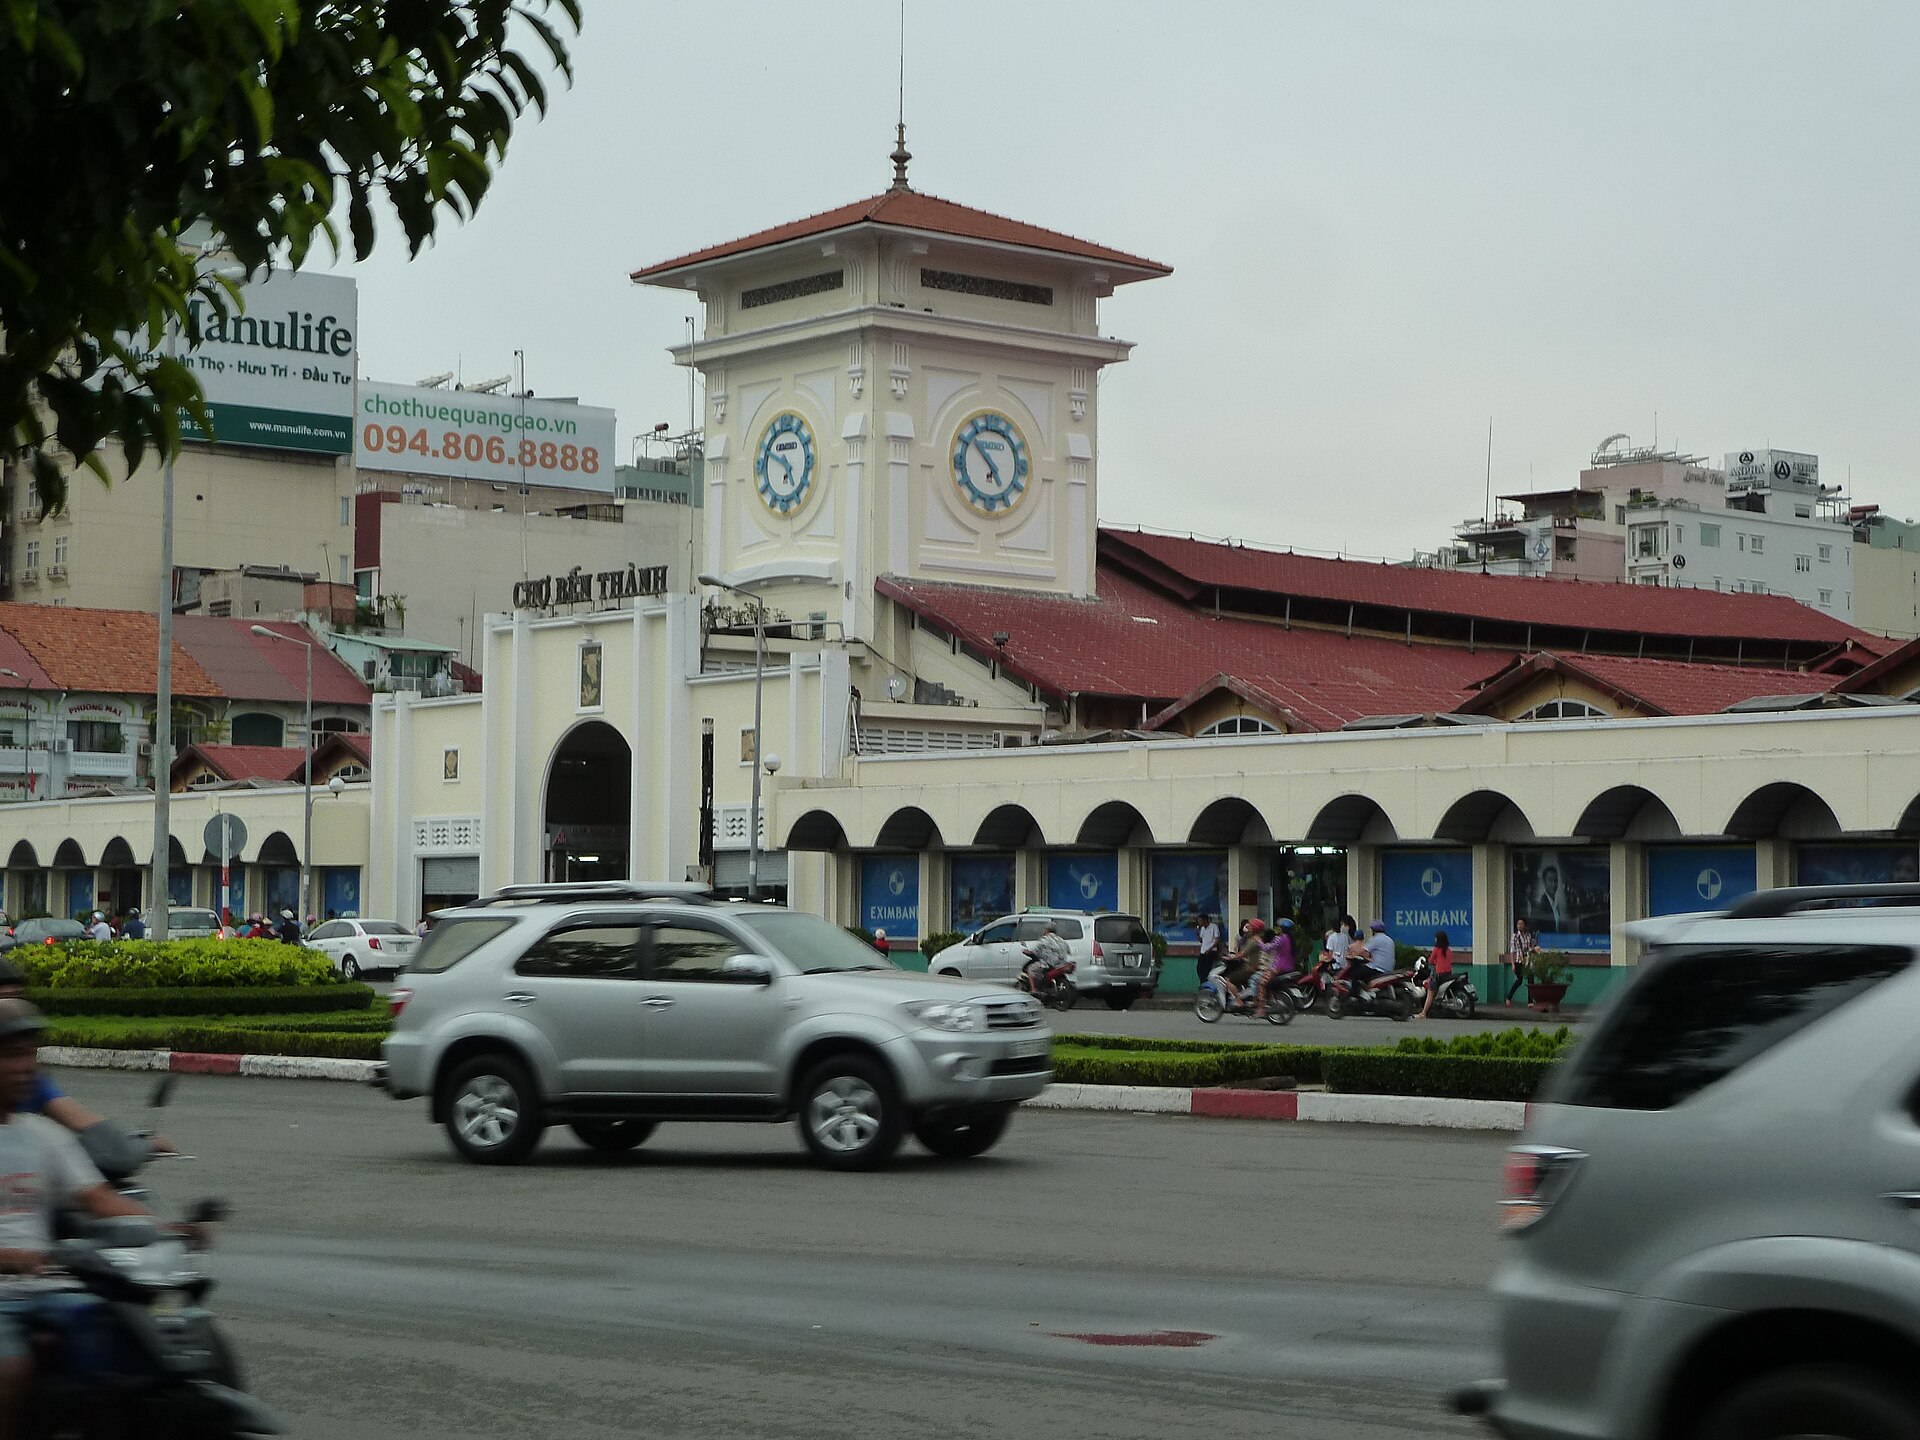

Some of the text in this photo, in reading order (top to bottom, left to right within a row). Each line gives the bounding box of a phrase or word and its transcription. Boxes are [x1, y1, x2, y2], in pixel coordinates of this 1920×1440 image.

[198, 356, 225, 373] Thọ
[364, 393, 577, 434] chothuequangcao.vn
[249, 421, 346, 439] www.manulife.com.vn
[363, 423, 600, 475] 094.806.8888
[596, 562, 668, 600] THÀNH
[1395, 910, 1469, 926] EXIMBANK
